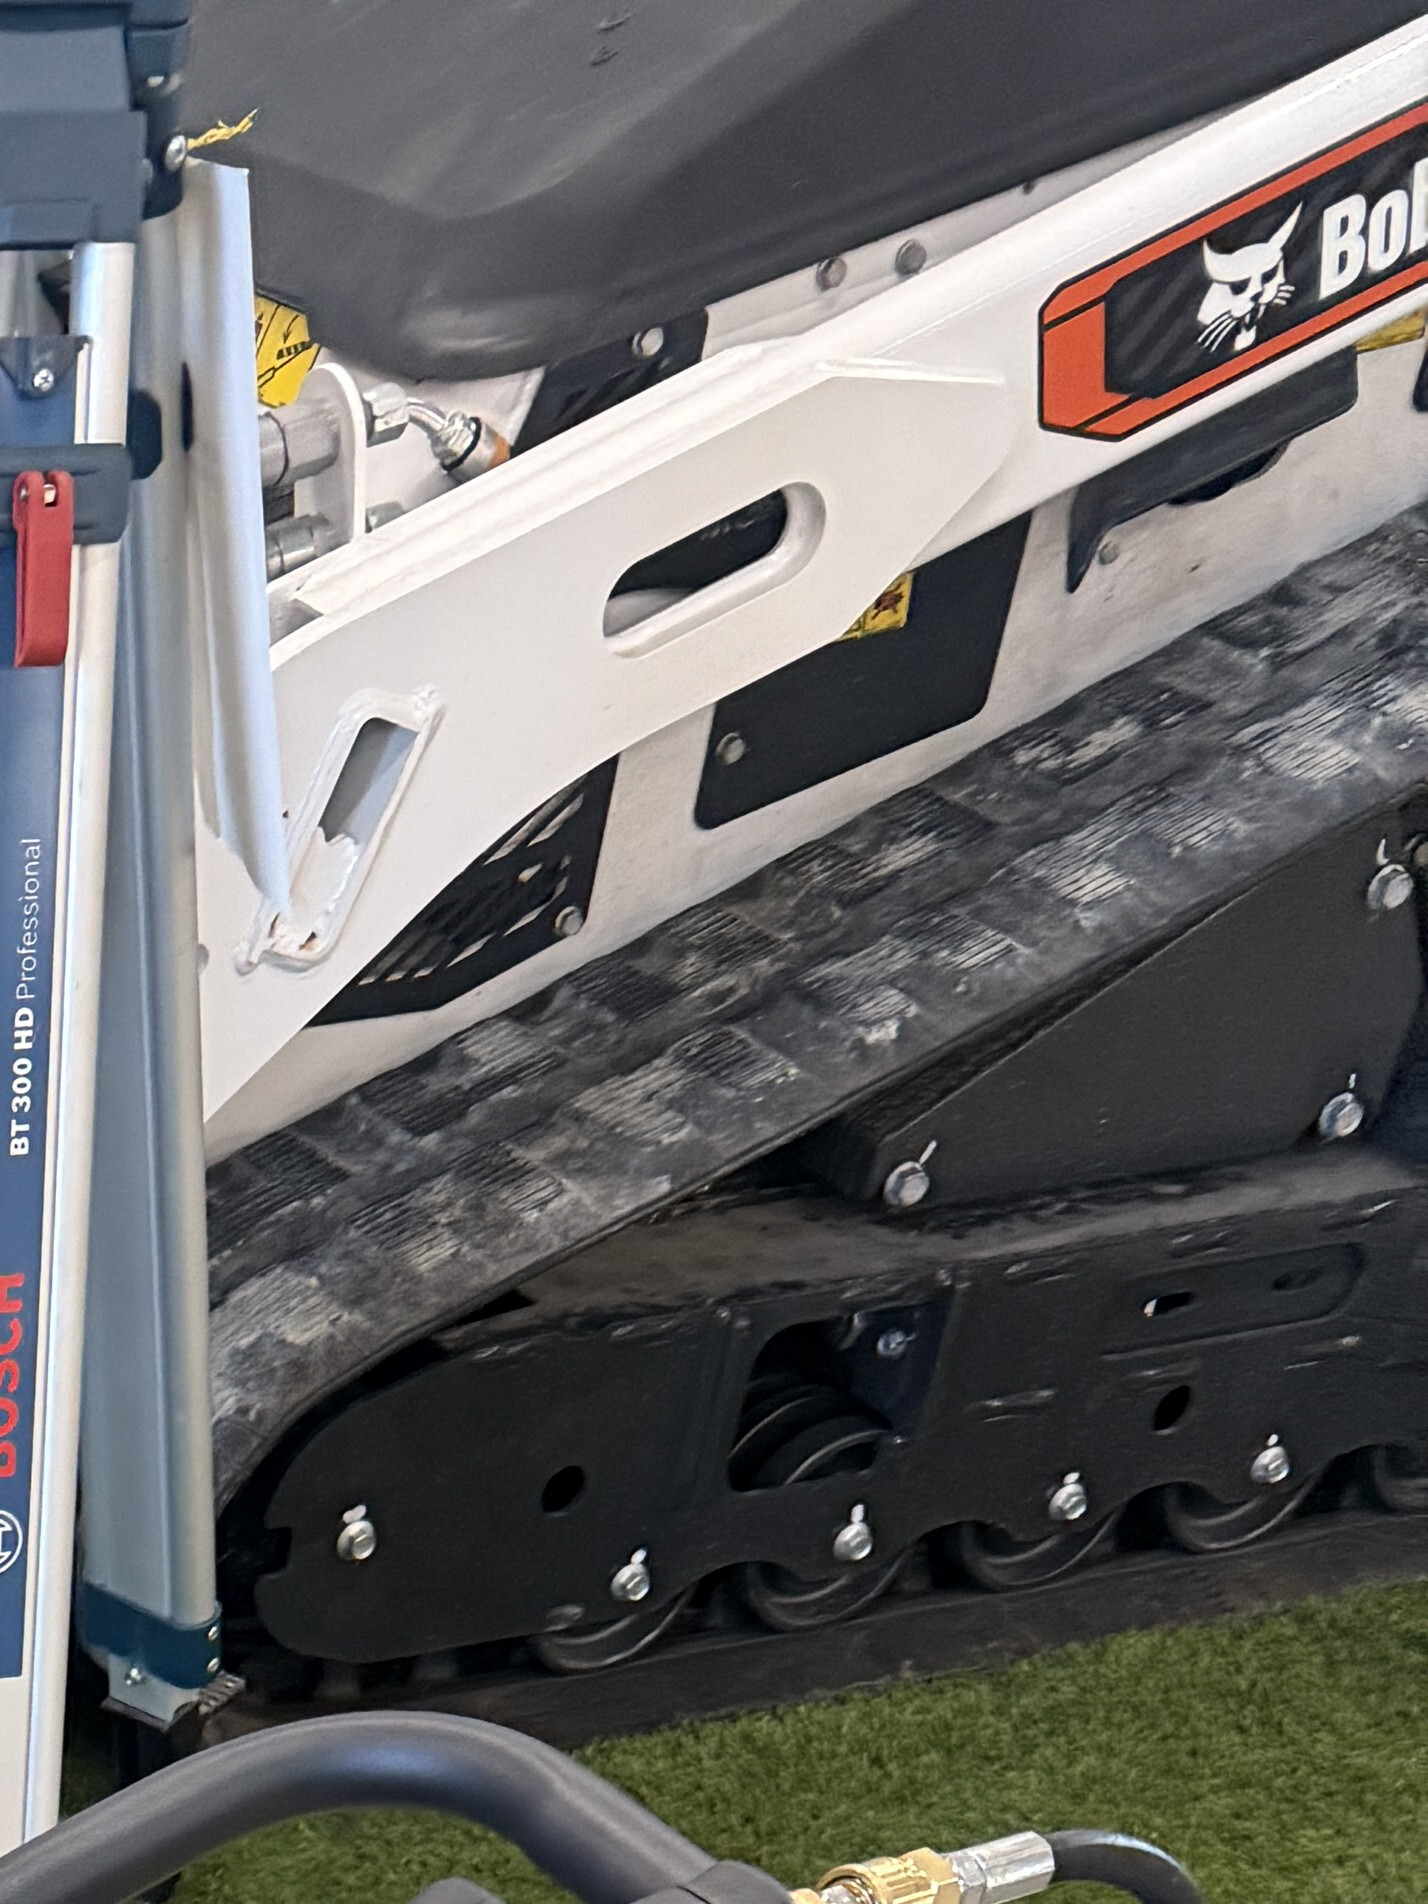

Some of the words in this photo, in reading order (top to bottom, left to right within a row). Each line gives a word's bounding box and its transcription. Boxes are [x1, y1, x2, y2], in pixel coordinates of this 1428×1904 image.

[16, 838, 41, 1000] Professional
[13, 1006, 34, 1050] HD
[11, 1057, 33, 1115] 300
[10, 1120, 30, 1156] BT
